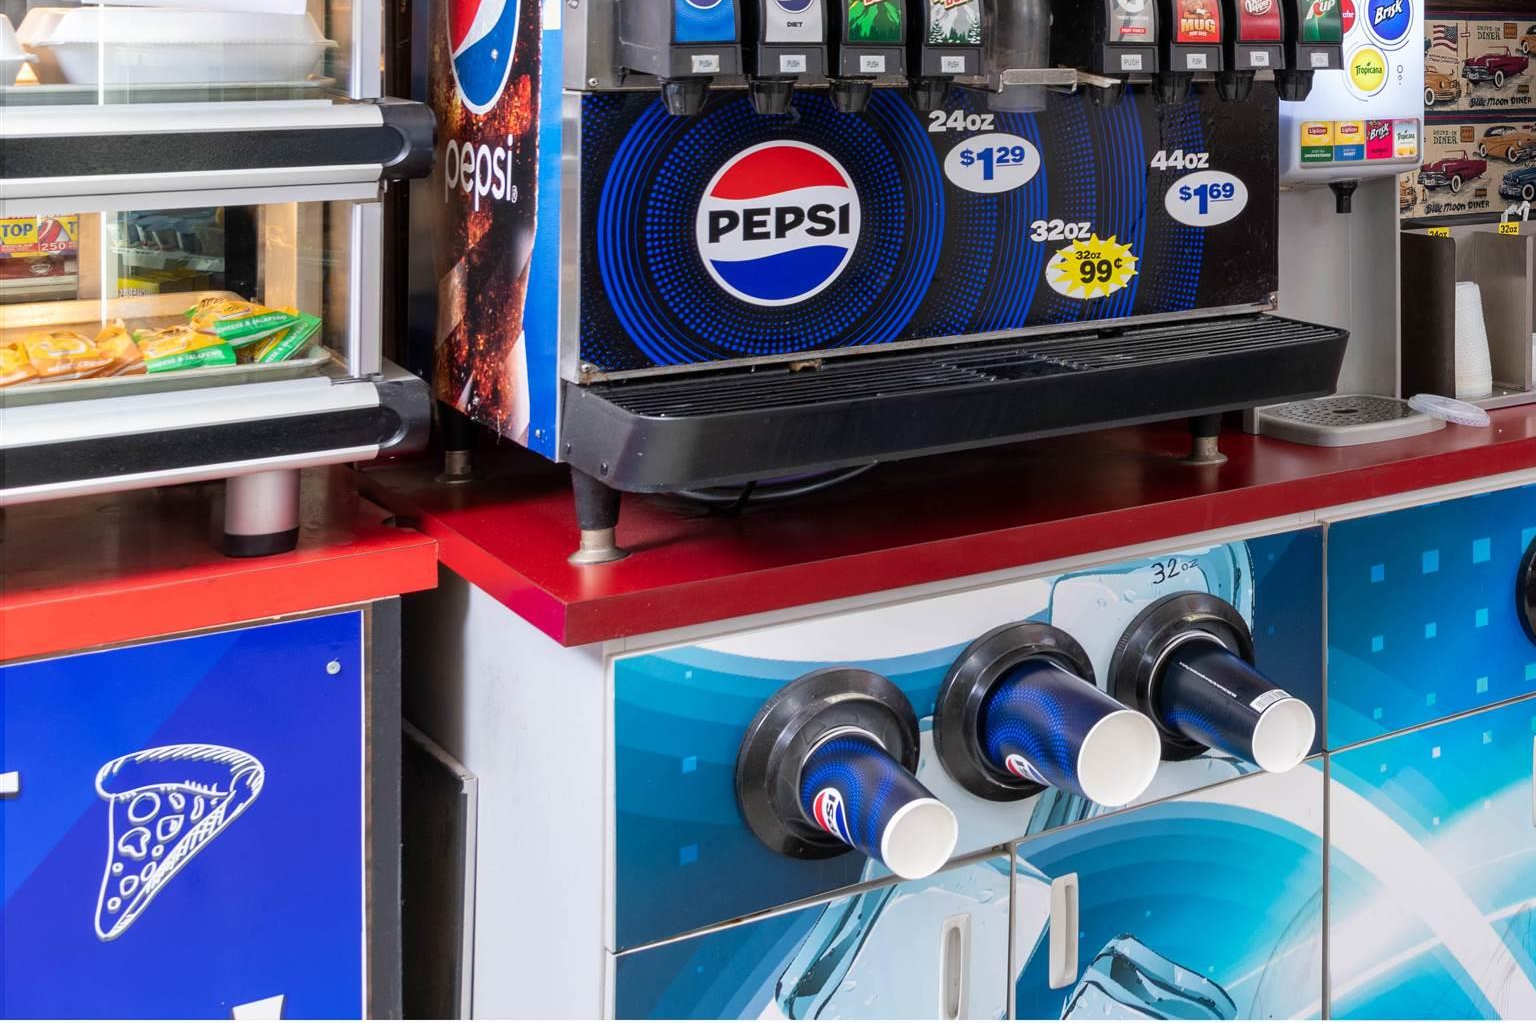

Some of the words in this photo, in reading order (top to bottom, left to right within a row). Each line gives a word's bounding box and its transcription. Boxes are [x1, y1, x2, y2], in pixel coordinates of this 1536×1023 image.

[786, 20, 803, 28] DIET
[1181, 18, 1216, 33] MUG
[1477, 32, 1501, 41] DINER
[1124, 58, 1140, 66] PUSH
[1356, 64, 1382, 76] Tropicana
[1487, 97, 1509, 107] Moon
[1510, 97, 1532, 105] DINER
[928, 110, 994, 131] 24oz
[1433, 136, 1457, 145] DINER
[1150, 150, 1209, 171] 44oz
[444, 134, 513, 211] pepsi
[1443, 203, 1466, 212] Moon
[1467, 201, 1490, 209] DINER
[707, 202, 851, 243] PEPSI
[1030, 219, 1091, 241] 32oz
[1500, 224, 1518, 234] 32oz
[41, 242, 66, 251] 250
[1075, 250, 1102, 261] 32oz
[1079, 258, 1123, 283] 99¢
[1152, 557, 1179, 585] 32
